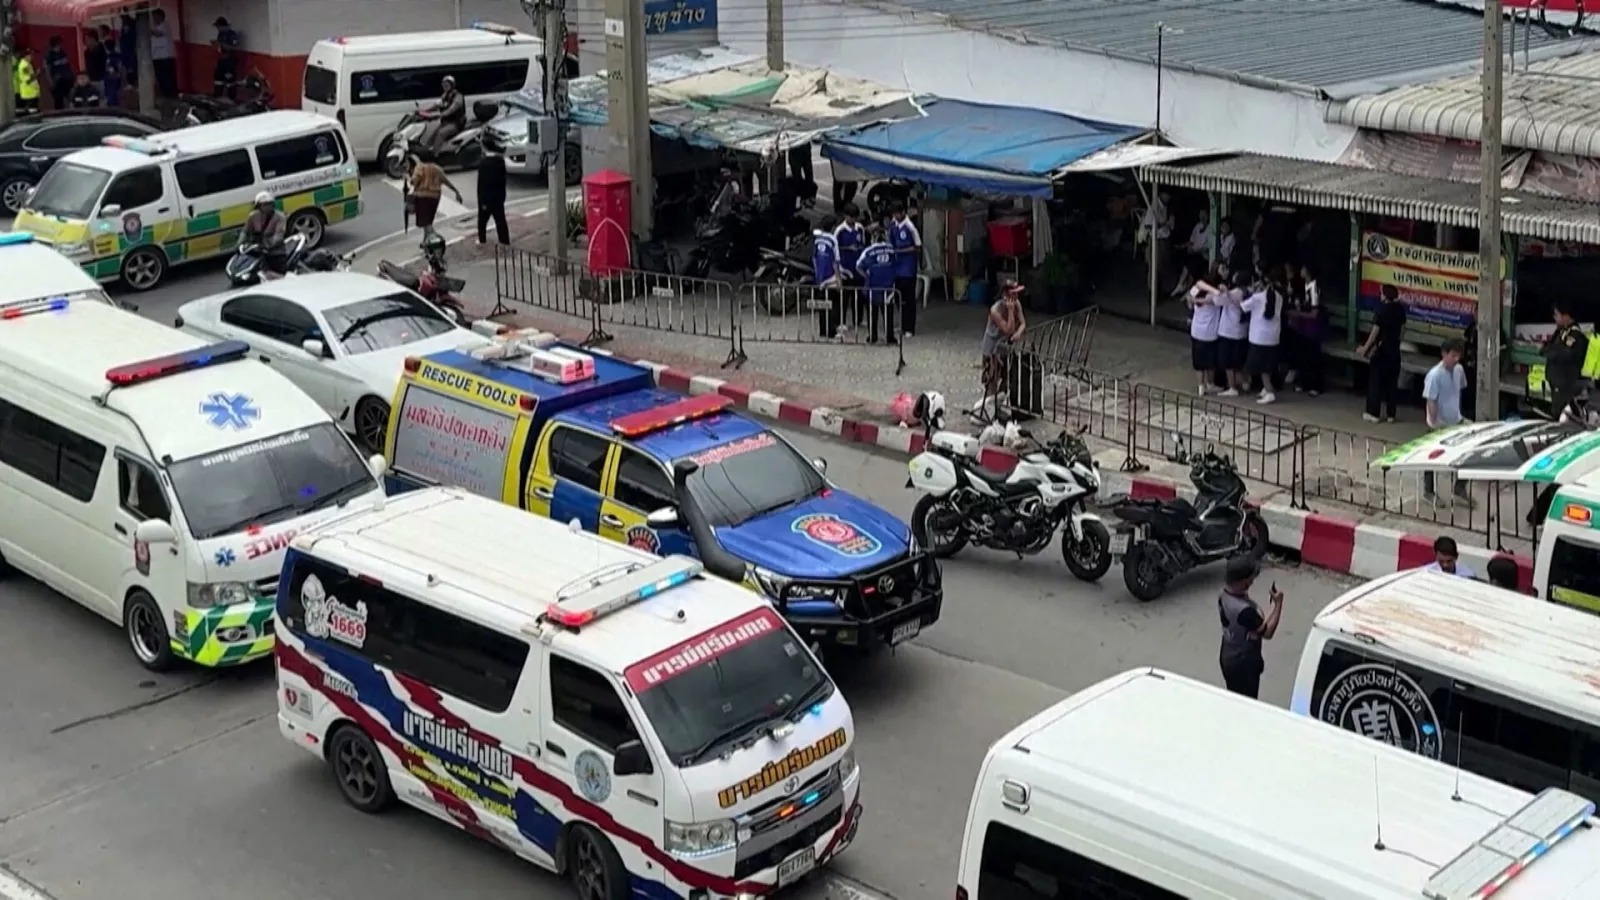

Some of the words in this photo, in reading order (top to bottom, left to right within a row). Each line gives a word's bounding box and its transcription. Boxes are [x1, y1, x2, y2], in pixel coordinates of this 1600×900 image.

[422, 365, 473, 393] RESCUE
[477, 382, 518, 407] TOOLS
[333, 614, 365, 640] 1669
